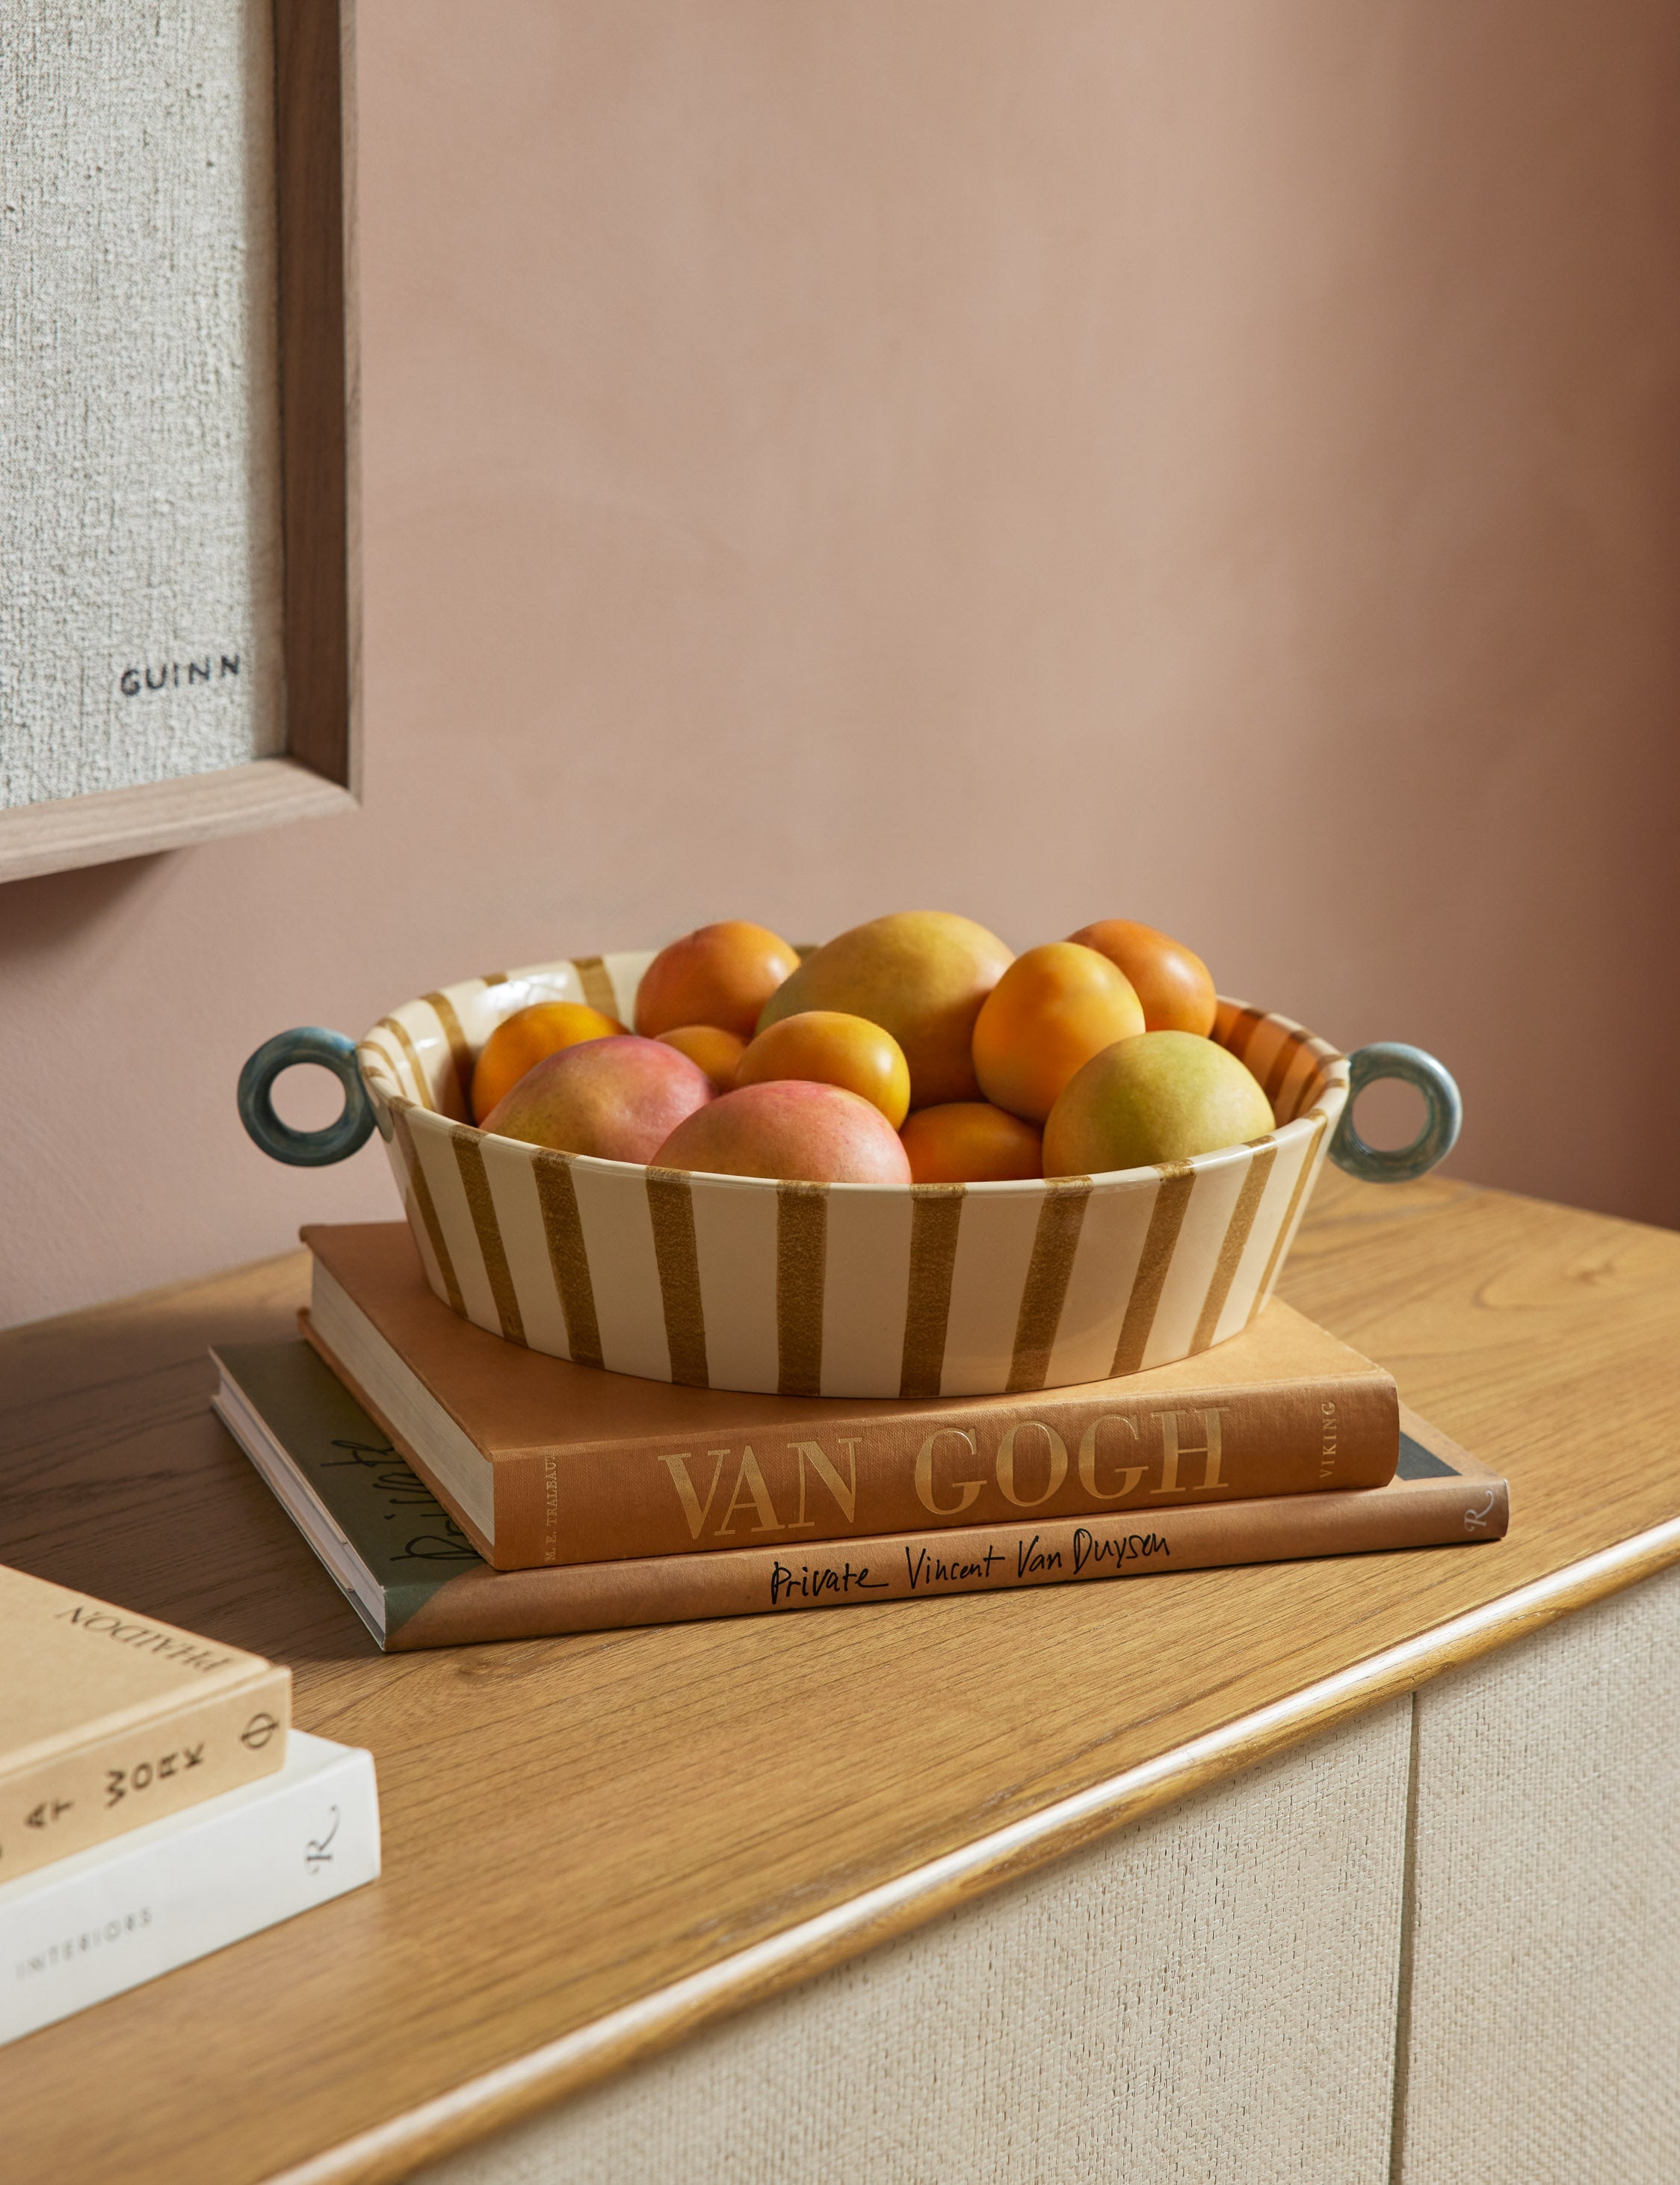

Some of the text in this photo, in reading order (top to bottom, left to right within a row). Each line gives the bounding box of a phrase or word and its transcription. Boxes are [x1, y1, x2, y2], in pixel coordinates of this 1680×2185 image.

[120, 653, 241, 697] GUINN
[658, 1406, 1230, 1540] VAN GOGH
[1320, 1401, 1337, 1479] VIKING
[770, 1527, 1171, 1605] Private Vincent Van Duysen
[54, 1606, 233, 1674] PHAIDON
[24, 1742, 206, 1830] AT WORK
[15, 1906, 152, 1982] INTERIORS
